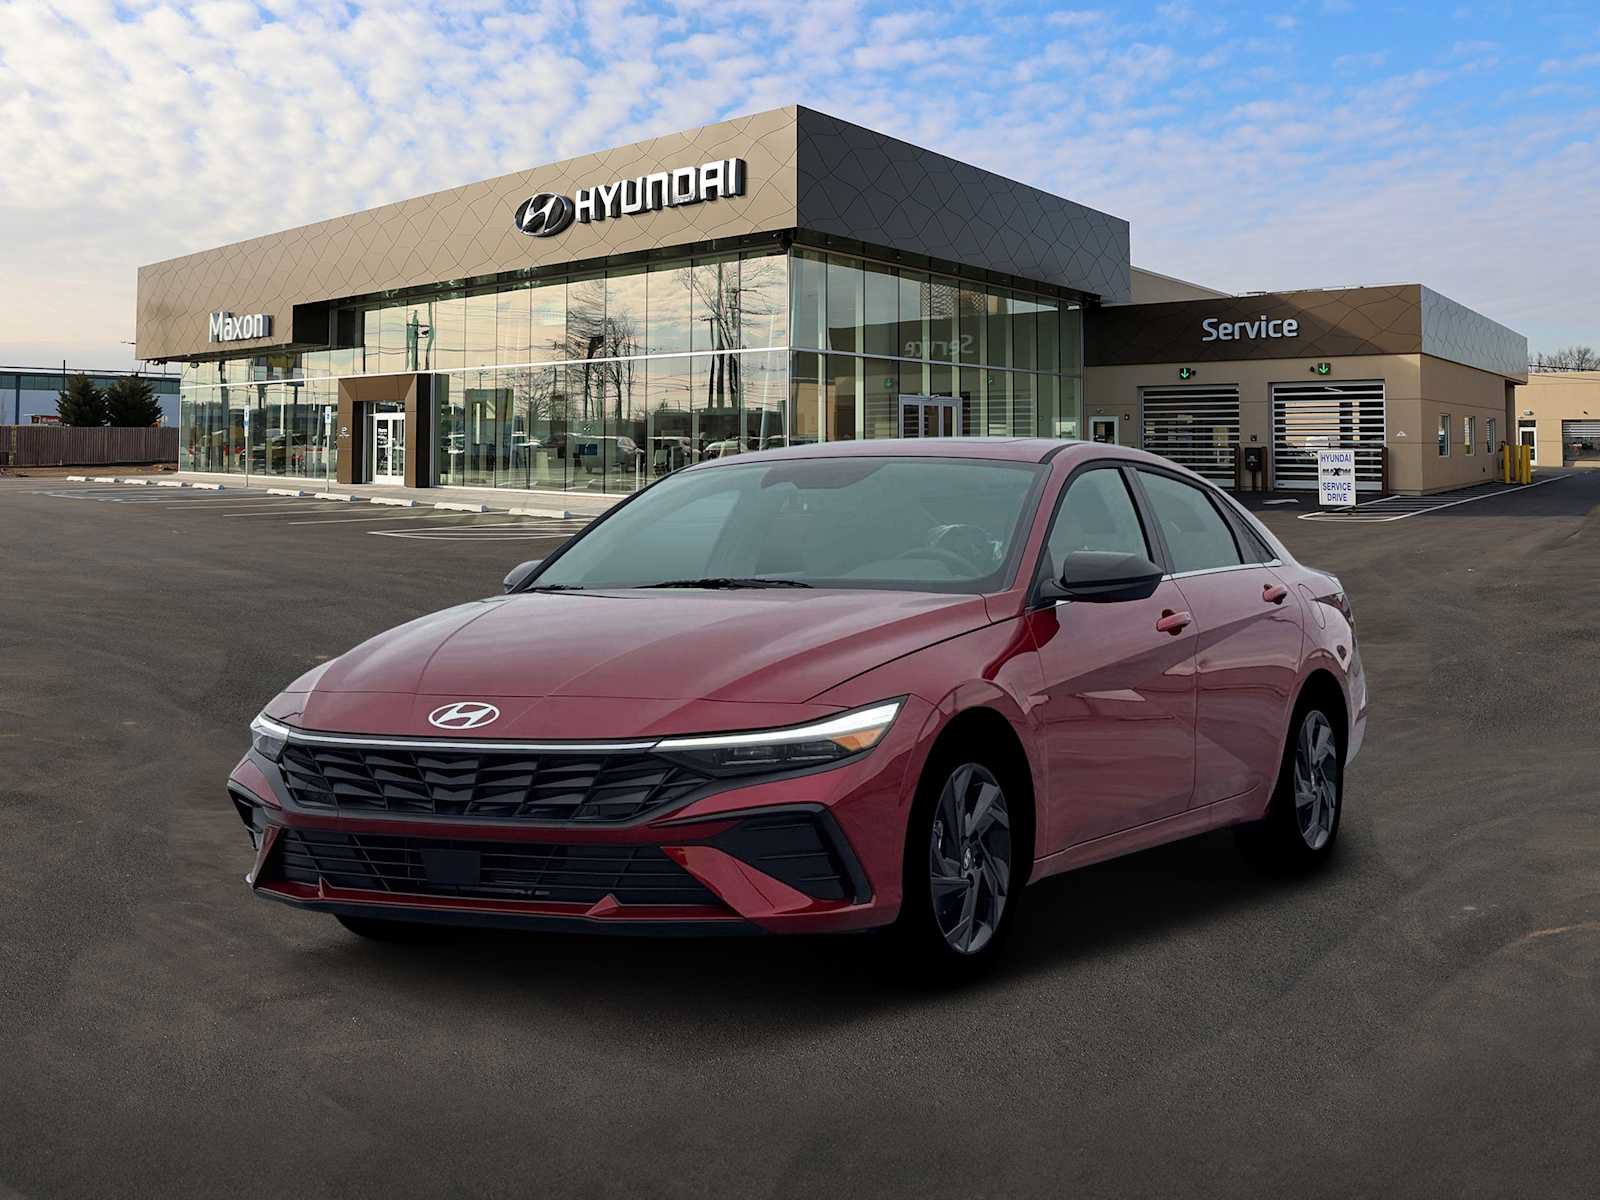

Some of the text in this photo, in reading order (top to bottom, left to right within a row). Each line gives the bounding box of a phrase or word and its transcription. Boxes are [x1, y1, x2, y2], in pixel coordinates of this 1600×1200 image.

[575, 158, 742, 222] HYUNDAI
[208, 311, 267, 342] Maxon
[1202, 314, 1298, 341] Service
[1321, 453, 1351, 463] HYUNDAI
[1322, 482, 1352, 491] SERVICE
[1327, 493, 1348, 502] DRIVE
